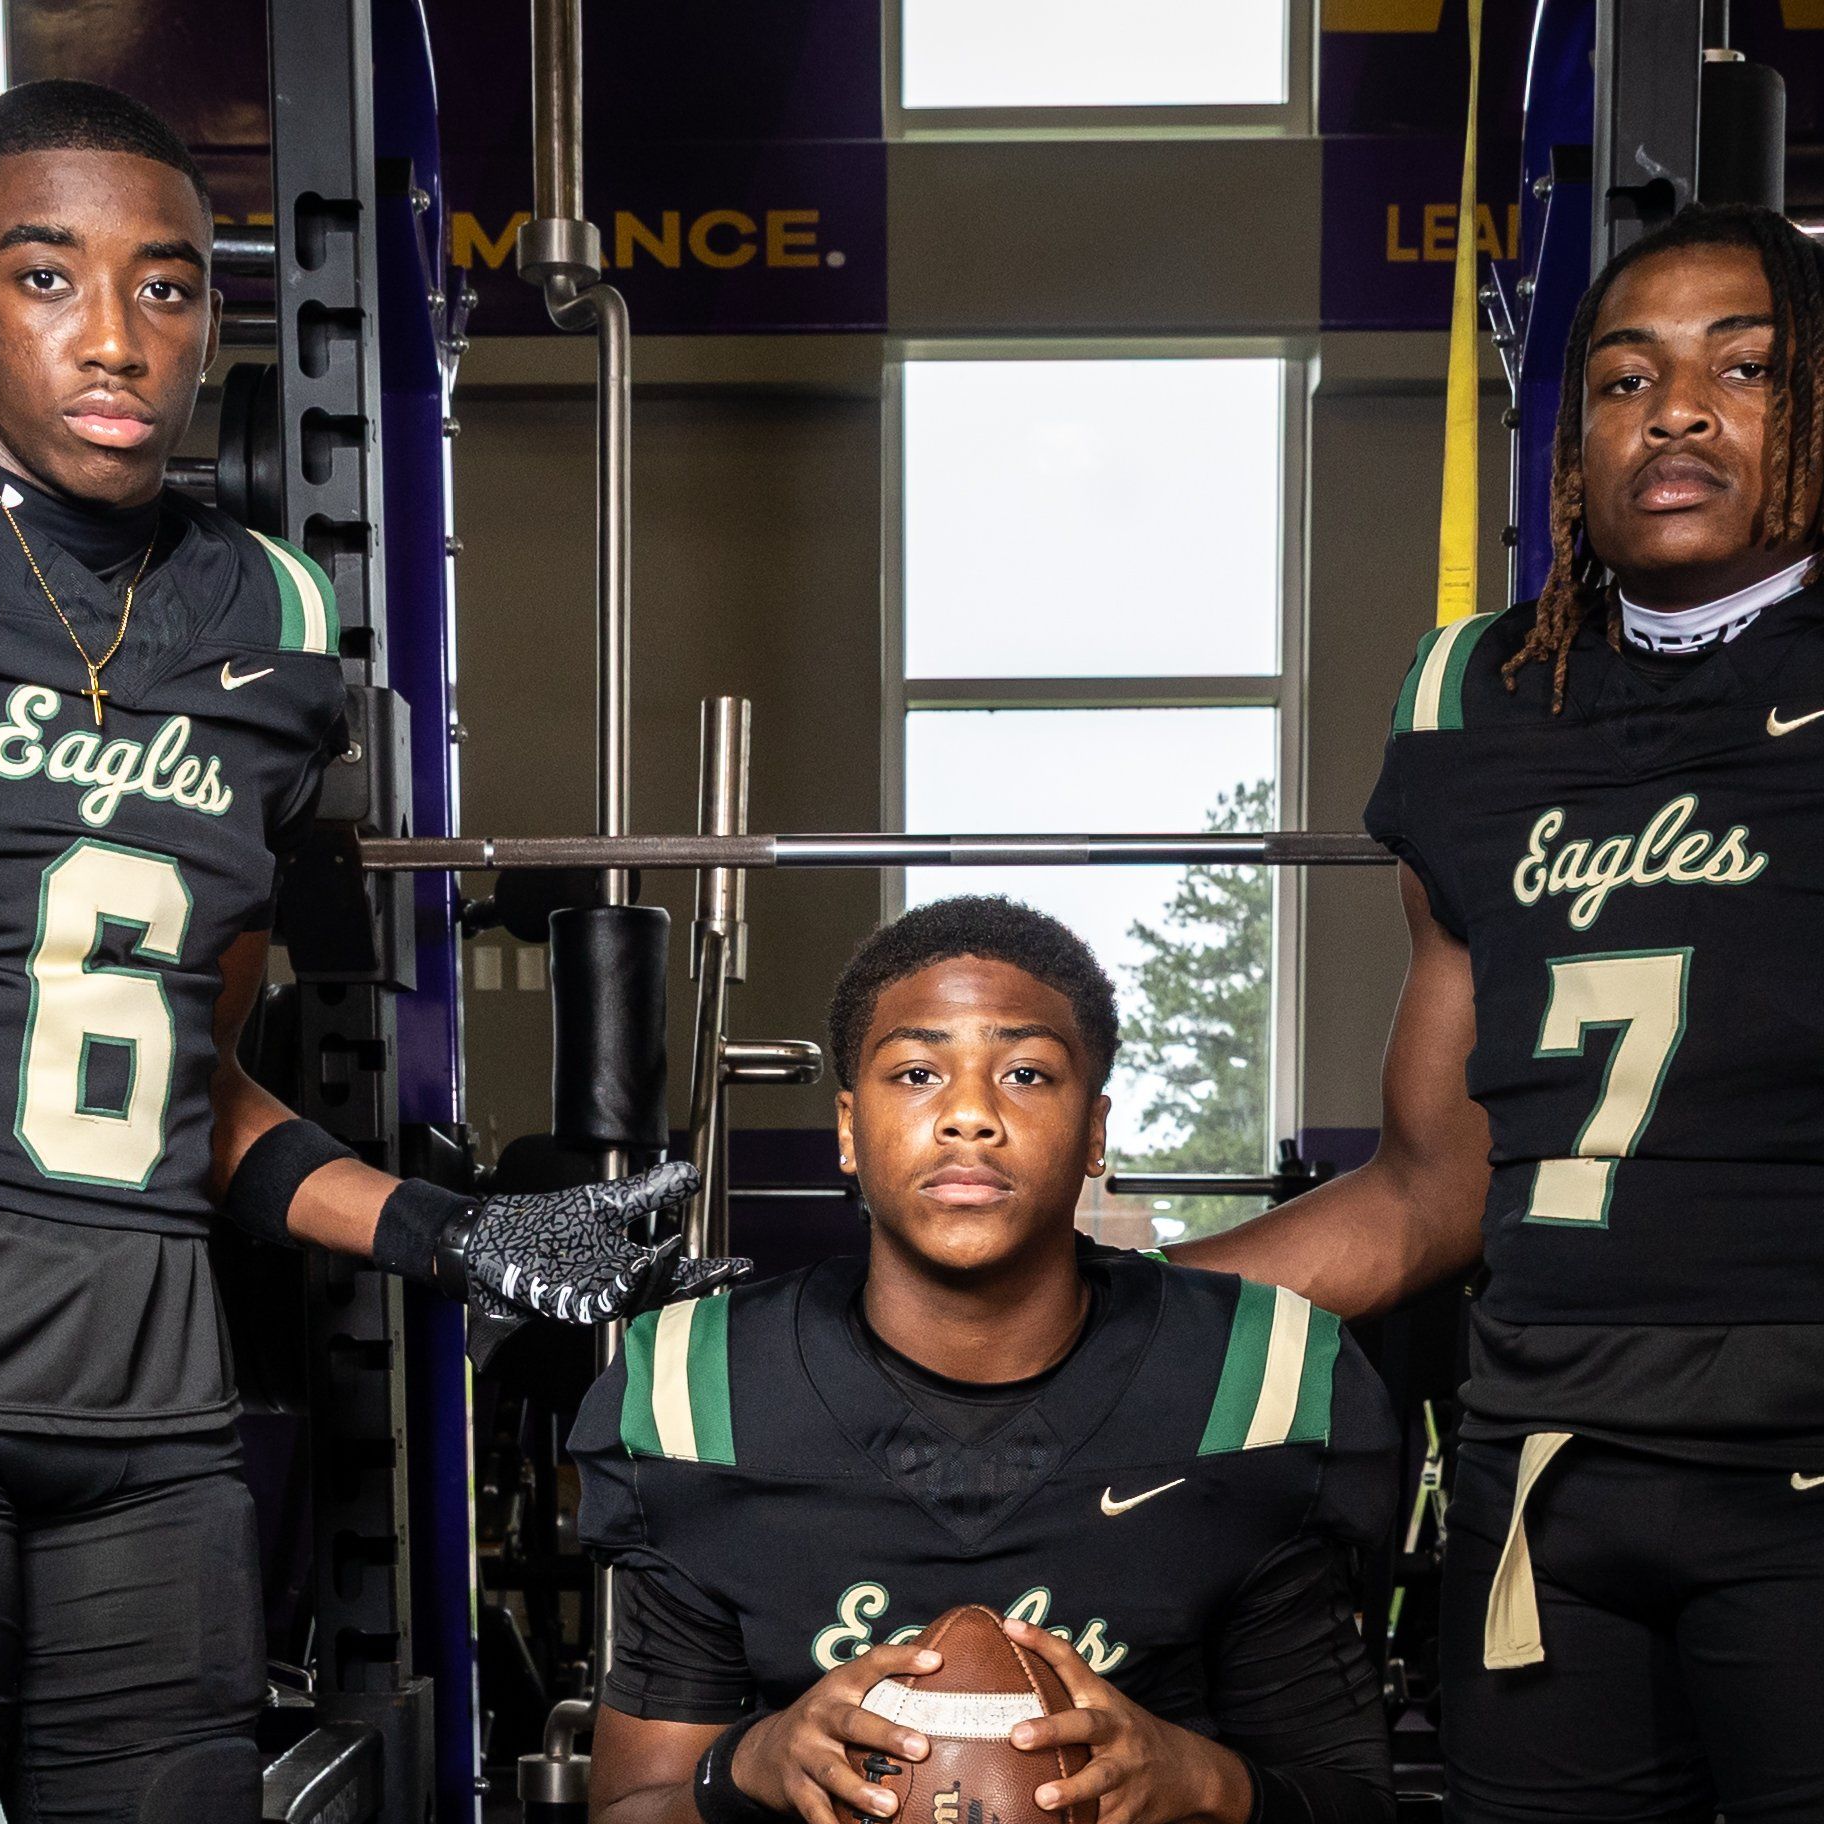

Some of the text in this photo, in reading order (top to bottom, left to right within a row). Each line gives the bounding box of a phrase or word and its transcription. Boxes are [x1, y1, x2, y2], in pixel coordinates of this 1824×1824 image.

[450, 208, 847, 269] MNCE.
[1512, 792, 1770, 932] Eagles
[12, 836, 195, 1192] 6
[1522, 946, 1695, 1230] 7
